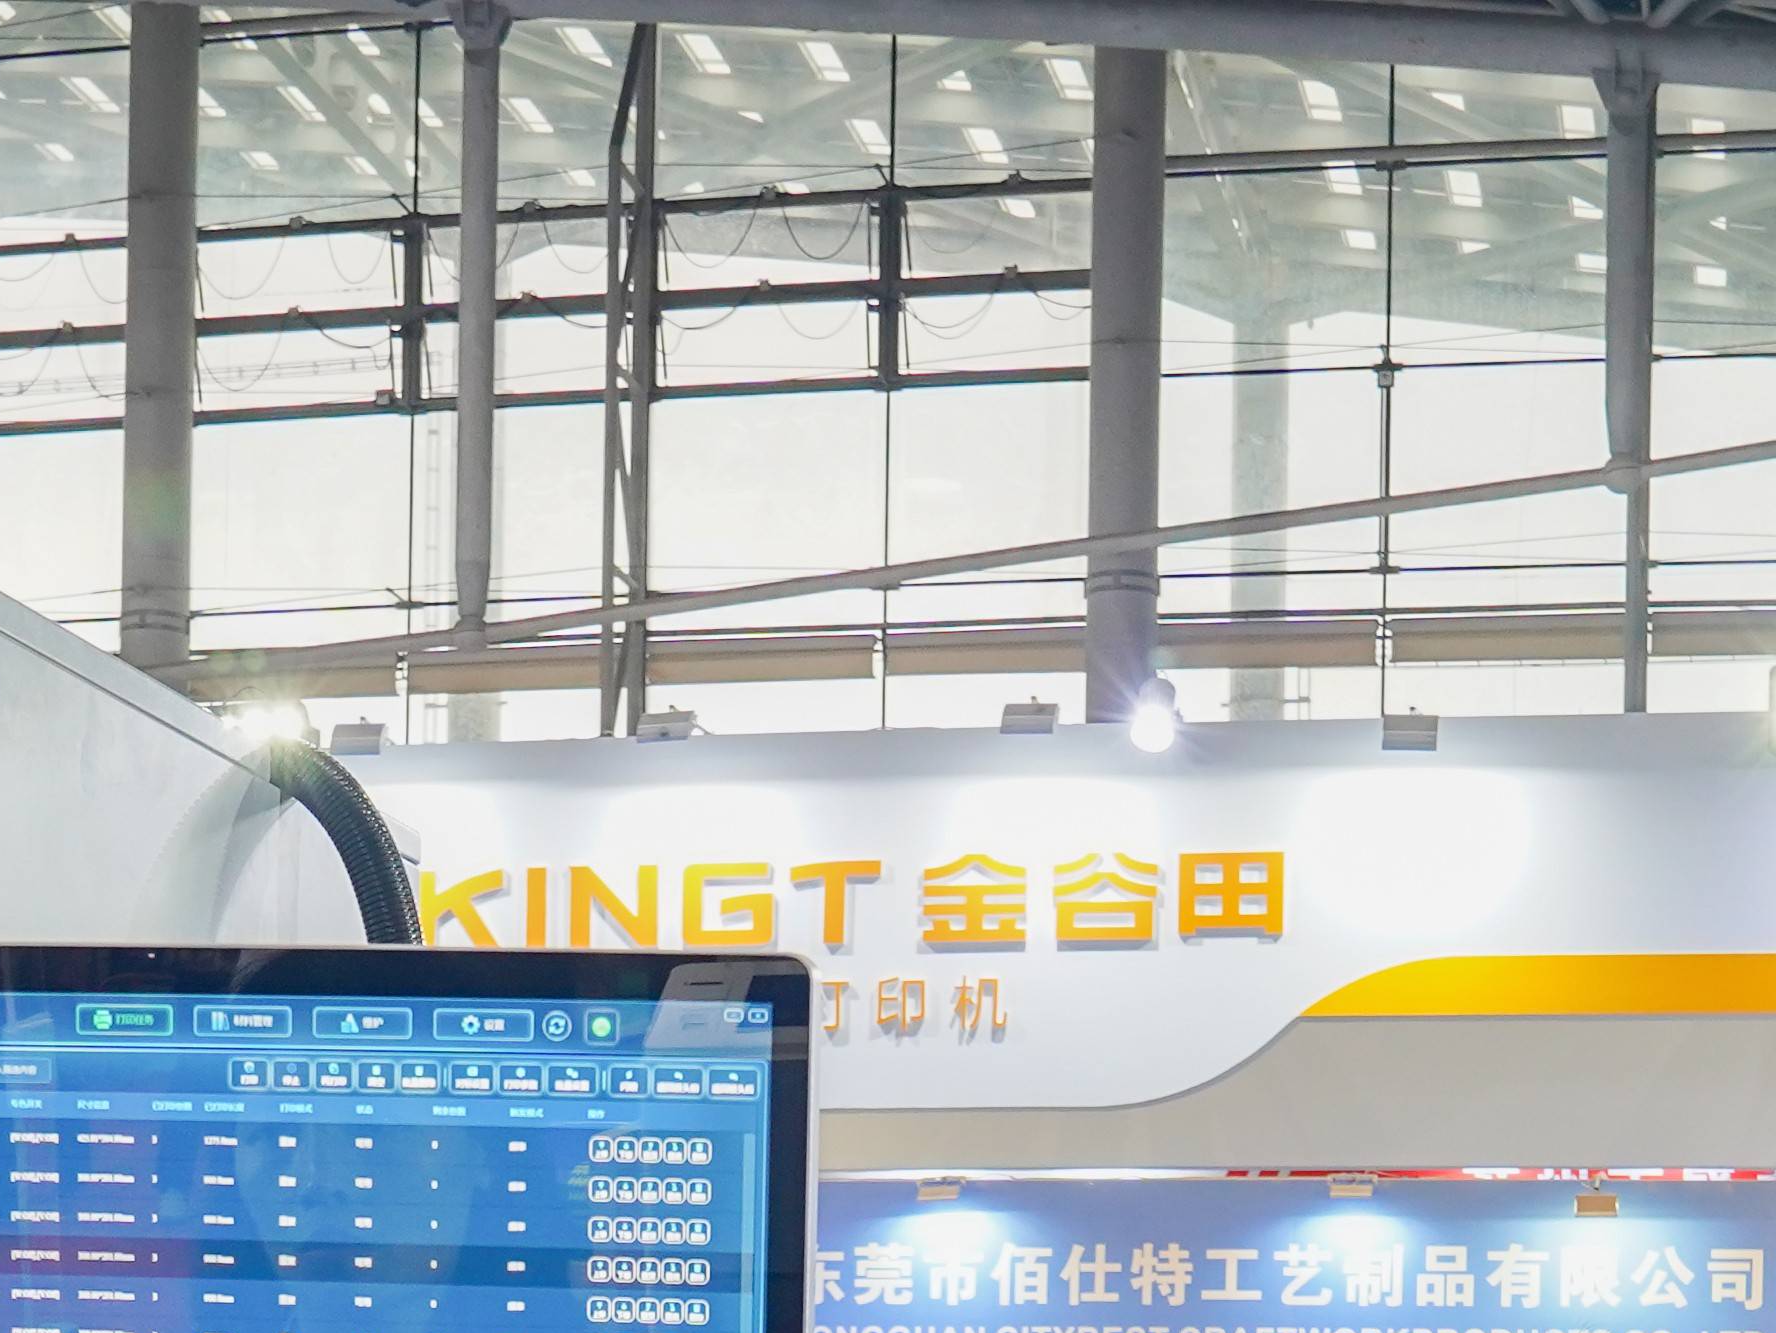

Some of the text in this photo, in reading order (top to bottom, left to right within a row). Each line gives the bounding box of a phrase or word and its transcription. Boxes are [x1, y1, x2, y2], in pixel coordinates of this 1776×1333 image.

[421, 852, 1285, 947] KINGT 金谷田
